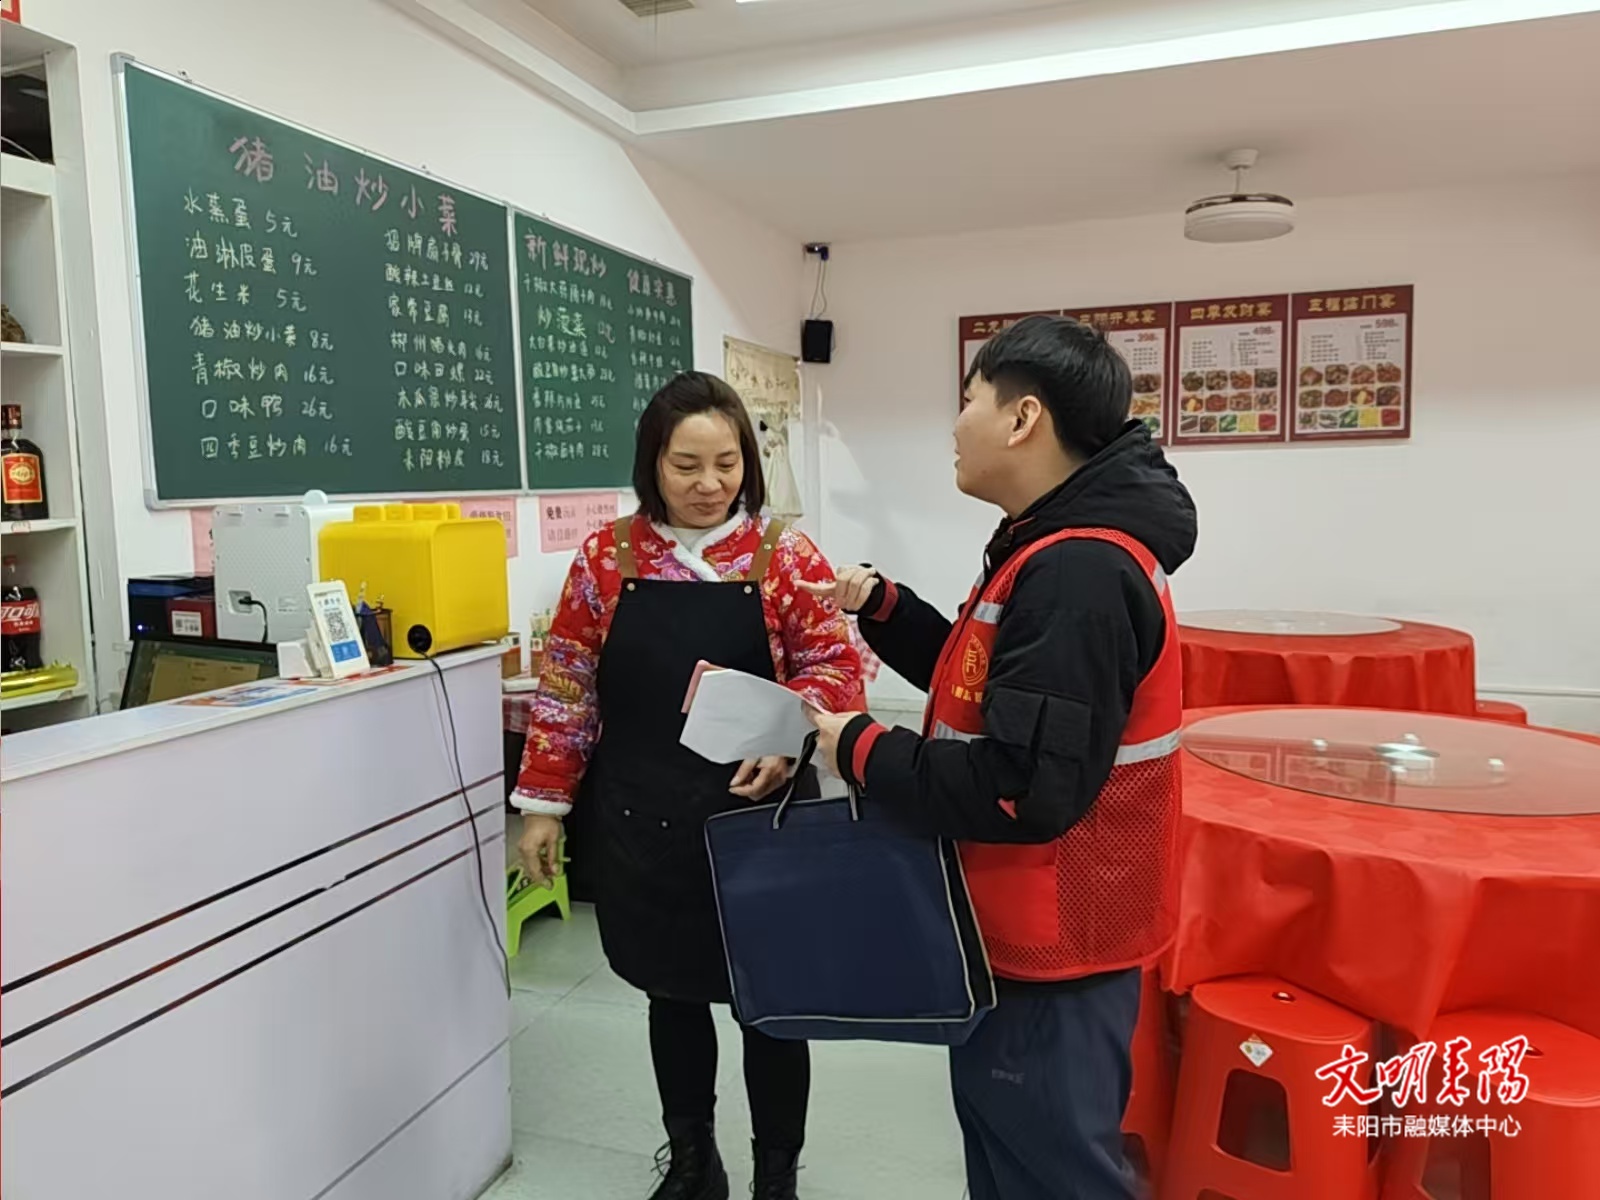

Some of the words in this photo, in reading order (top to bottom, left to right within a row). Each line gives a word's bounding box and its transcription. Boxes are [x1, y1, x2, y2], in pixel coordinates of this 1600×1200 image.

[230, 136, 457, 237] 猪油炒小菜
[184, 186, 251, 229] 水蒸蛋
[265, 209, 298, 238] 5元
[184, 229, 277, 275] 油淋皮蛋
[291, 252, 318, 276] 9元
[524, 227, 607, 279] 新鲜现炒
[184, 270, 250, 305] 花生米
[276, 287, 307, 313] 5元
[1308, 293, 1397, 313] 五福临门宴
[388, 292, 450, 328] 家常豆腐
[1375, 318, 1400, 329] 598
[190, 314, 297, 348] 猪油炒小菜
[310, 329, 334, 351] 8元
[1137, 332, 1159, 343] 398
[1253, 326, 1275, 336] 498
[191, 351, 289, 385] 青椒炒肉
[303, 364, 334, 385] 16元
[394, 360, 466, 384] 口味田螺
[201, 394, 284, 420] 口味鸭
[301, 395, 333, 420] 26元
[201, 431, 308, 460] 四季豆炒肉
[324, 433, 353, 457] 16元
